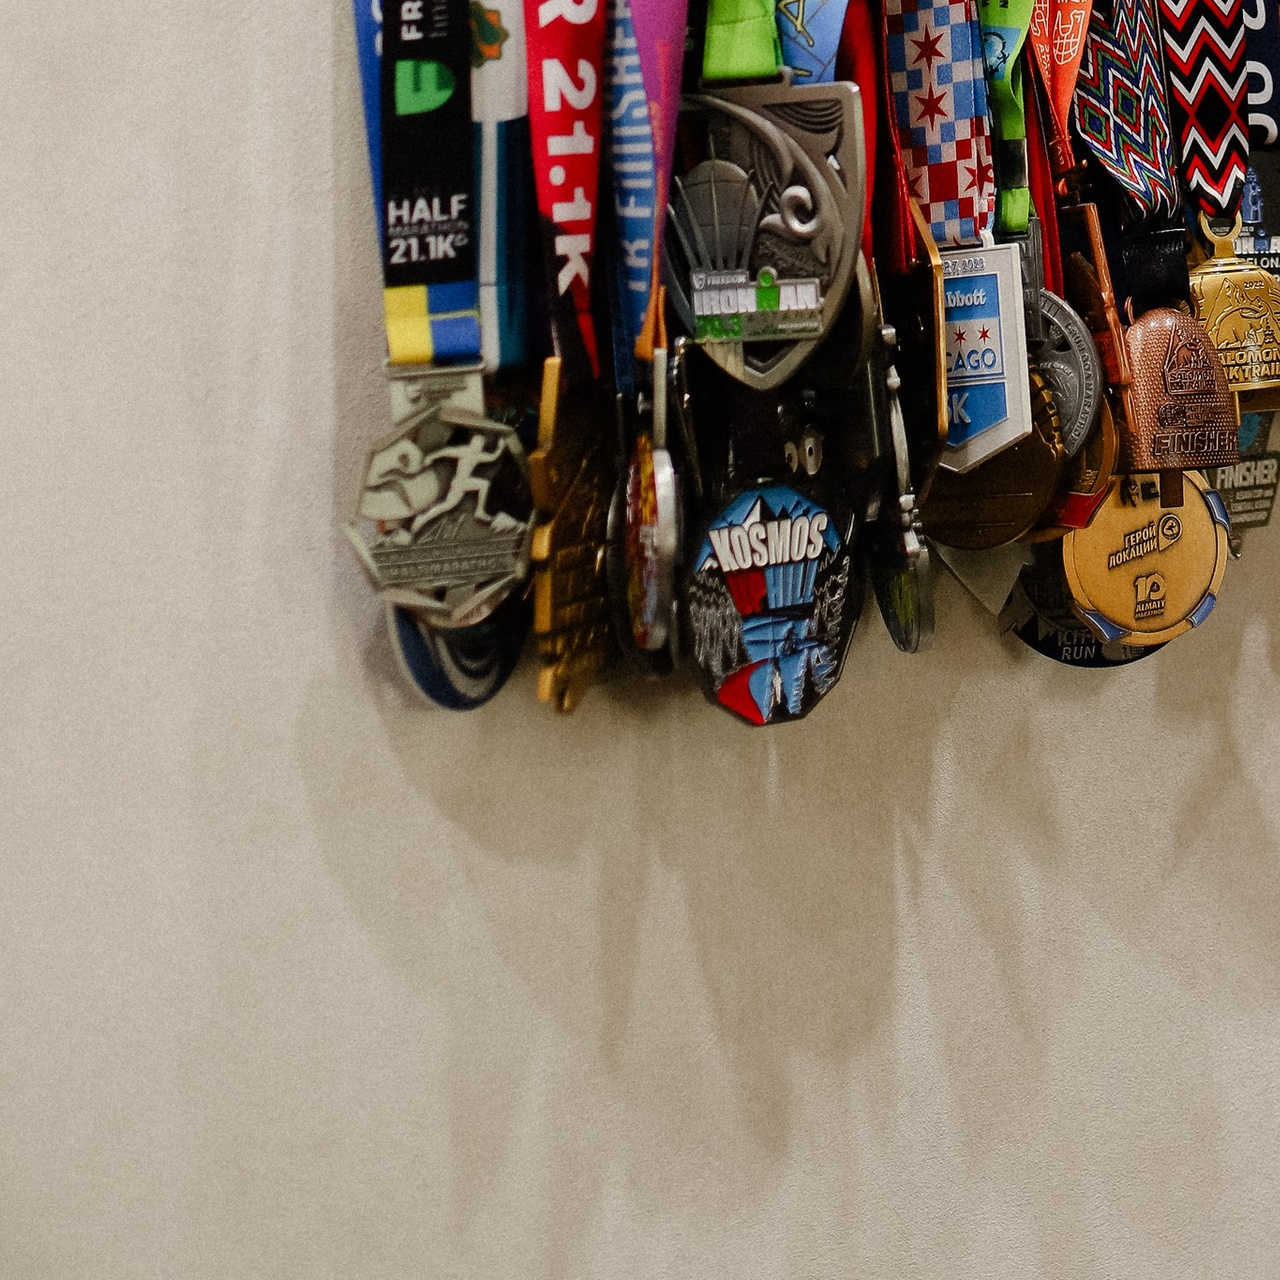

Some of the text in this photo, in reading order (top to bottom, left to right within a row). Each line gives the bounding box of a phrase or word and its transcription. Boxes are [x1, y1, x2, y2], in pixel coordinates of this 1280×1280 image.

[544, 57, 599, 296] 21.1K
[388, 193, 469, 227] HALF
[389, 232, 458, 265] 21.1K
[1217, 458, 1278, 490] FINISHER
[709, 512, 828, 572] KOSMOS
[1124, 521, 1158, 549] ГЕРОЙ
[1061, 644, 1097, 662] RUN
